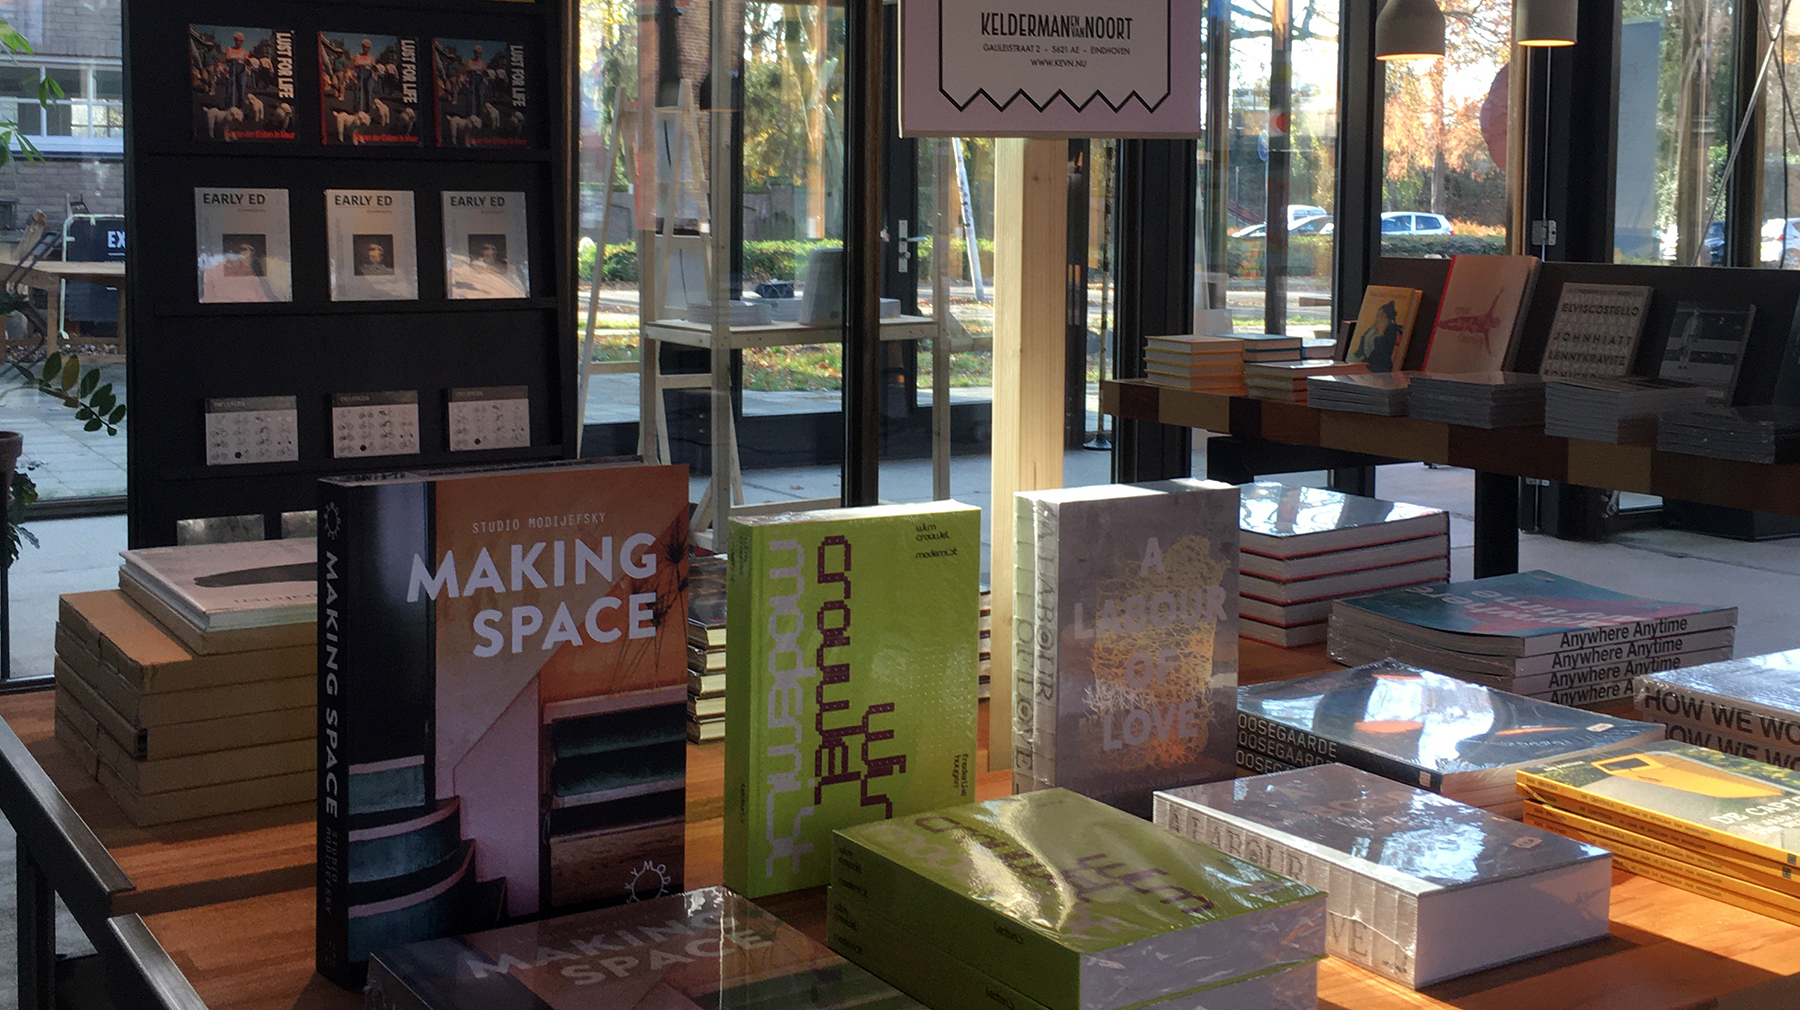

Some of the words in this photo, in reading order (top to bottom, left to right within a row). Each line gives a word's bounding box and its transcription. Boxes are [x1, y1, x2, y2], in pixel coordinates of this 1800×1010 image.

[981, 12, 1070, 38] KELDERMAN
[1085, 16, 1133, 40] NOORT
[275, 32, 293, 57] LUST
[401, 39, 416, 64] LUST
[510, 44, 525, 68] LUST
[1090, 46, 1131, 55] EINDHOVEN
[276, 57, 294, 77] FOR
[402, 64, 417, 82] FOR
[277, 77, 295, 99] LIFE
[402, 82, 418, 103] LIFE
[512, 87, 527, 107] LIFE
[203, 193, 244, 205] EARLY
[248, 193, 266, 205] ED
[334, 194, 373, 206] EARLY
[376, 194, 393, 207] ED
[450, 195, 487, 207] EARLY
[489, 195, 506, 207] ED
[472, 518, 521, 534] STUDIO
[528, 512, 607, 529] MODIJEFSKY
[406, 532, 657, 603] MAKING
[1140, 537, 1165, 575] A
[325, 551, 339, 697] MAKING
[472, 592, 657, 658] SPACE
[1036, 555, 1055, 701] LABOUR
[1073, 585, 1228, 640] LABOUR
[1015, 619, 1034, 666] OF
[1559, 626, 1630, 649] Anywhere
[1632, 617, 1688, 638] Anytime
[1125, 647, 1178, 690] OF
[1551, 646, 1623, 669] Anywhere
[1626, 637, 1684, 659] Anytime
[1548, 665, 1623, 689] Anywhere
[1624, 656, 1682, 676] Anytime
[1550, 683, 1623, 705] Anywhere
[1644, 686, 1705, 721] HOW
[1710, 701, 1753, 734] WE
[1015, 675, 1034, 772] LOVE
[1102, 700, 1198, 751] LOVE
[325, 707, 339, 818] SPACE
[1238, 730, 1333, 767] OOSEGAARD
[464, 912, 740, 979] MAKING
[1328, 912, 1368, 957] VE
[560, 928, 775, 986] SPACE
